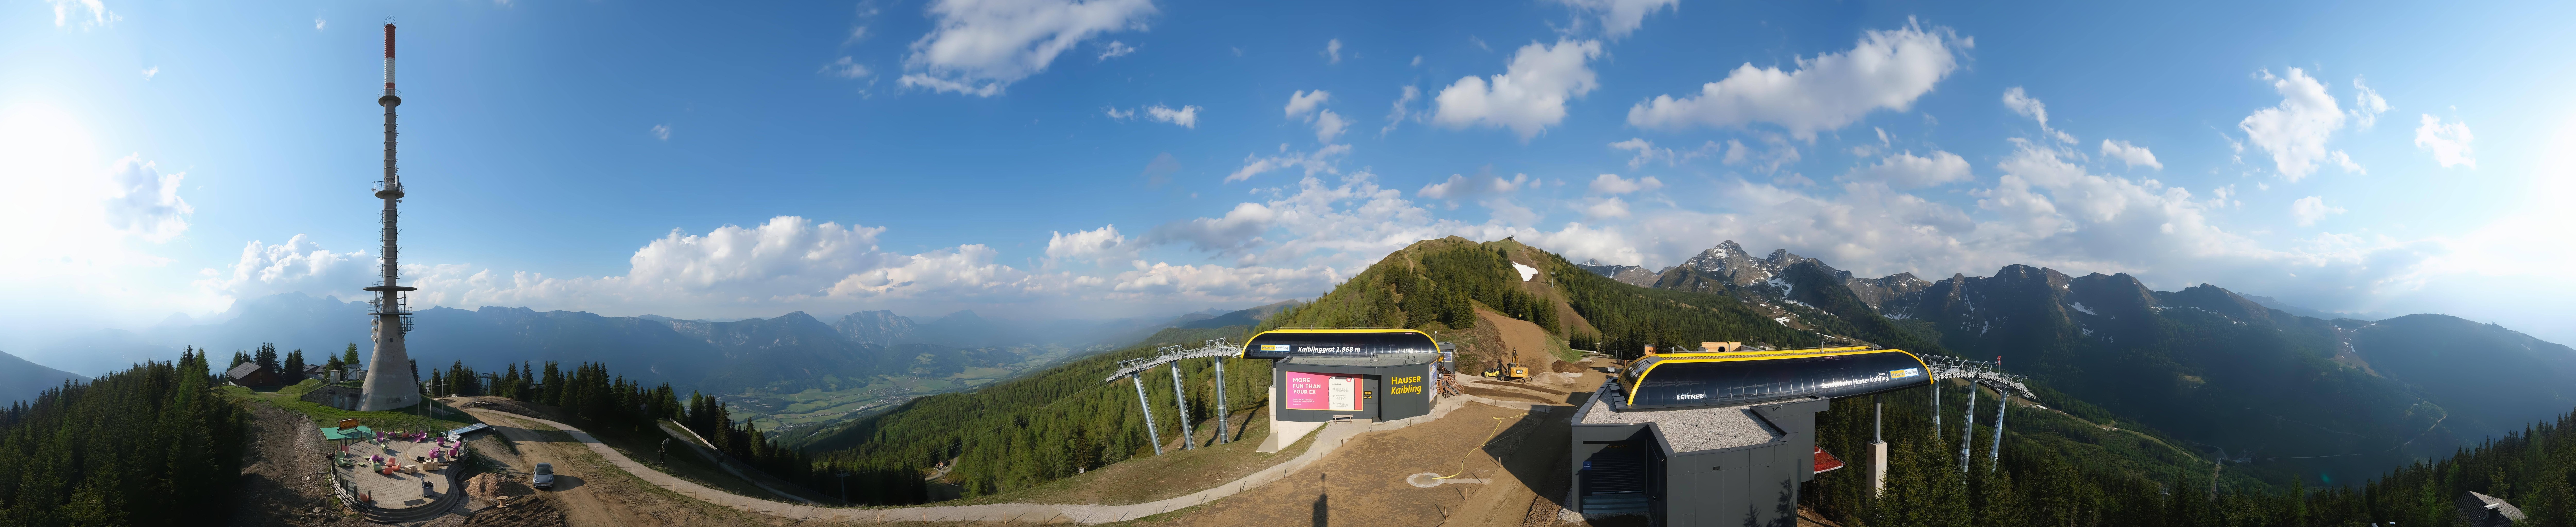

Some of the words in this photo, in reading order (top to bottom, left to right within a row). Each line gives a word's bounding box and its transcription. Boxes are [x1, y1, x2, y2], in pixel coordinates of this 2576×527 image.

[1392, 376, 1421, 385] HAUSER
[1821, 380, 1852, 388] Senderbahn
[1391, 385, 1422, 395] Kaibling
